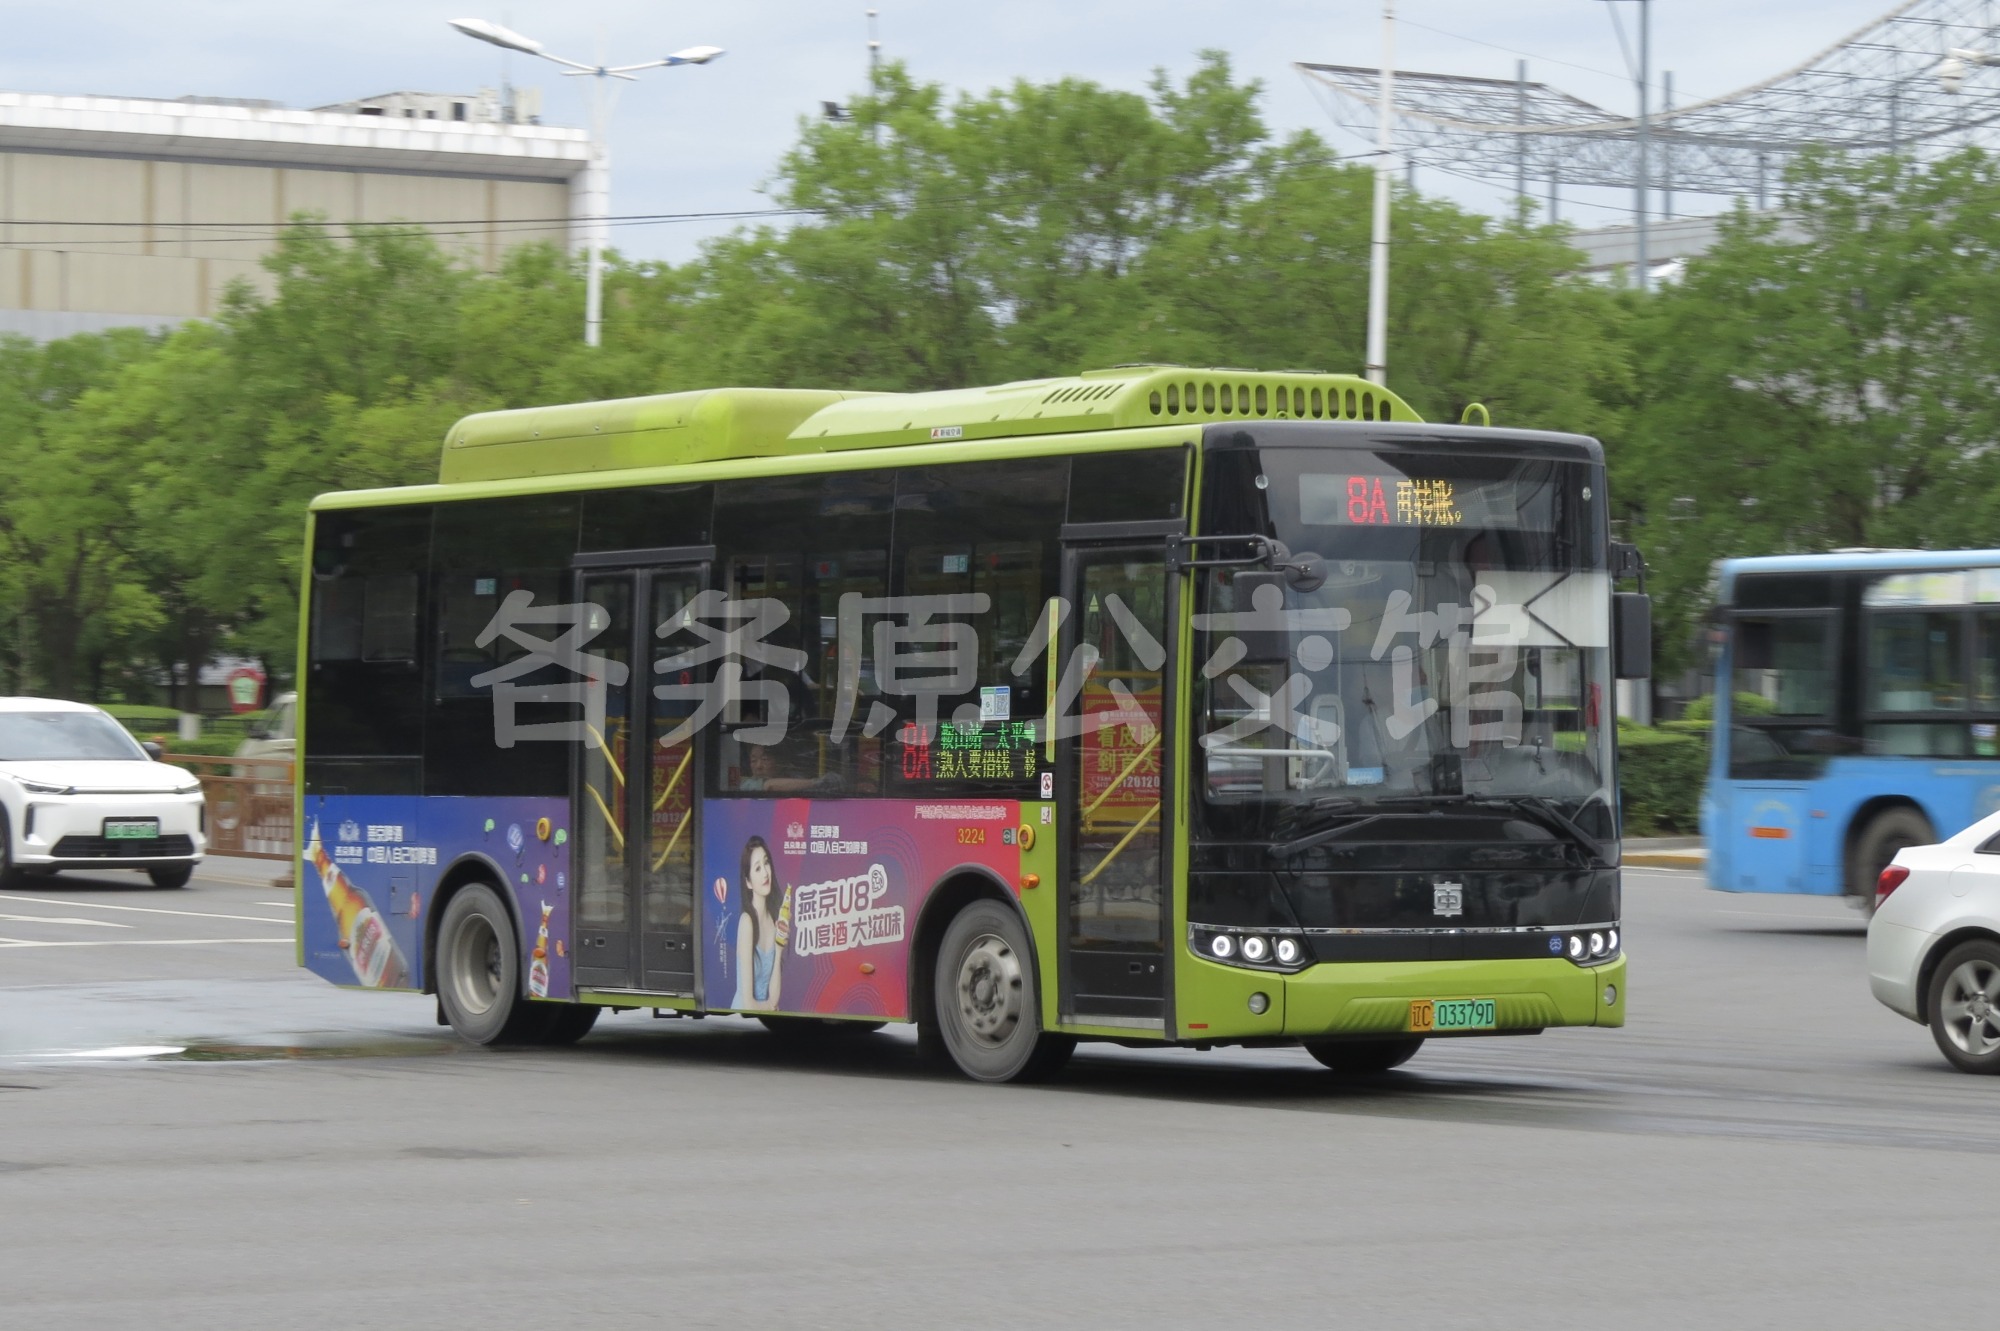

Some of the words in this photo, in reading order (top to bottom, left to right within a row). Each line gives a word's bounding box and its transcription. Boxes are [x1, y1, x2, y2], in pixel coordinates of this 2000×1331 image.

[1347, 475, 1390, 524] 8A
[810, 841, 868, 854] 中国人自己的啤酒
[958, 828, 985, 844] 3224
[798, 880, 870, 921] 燕京U8
[798, 920, 848, 950] 小度酒
[851, 911, 902, 942] 大滋味
